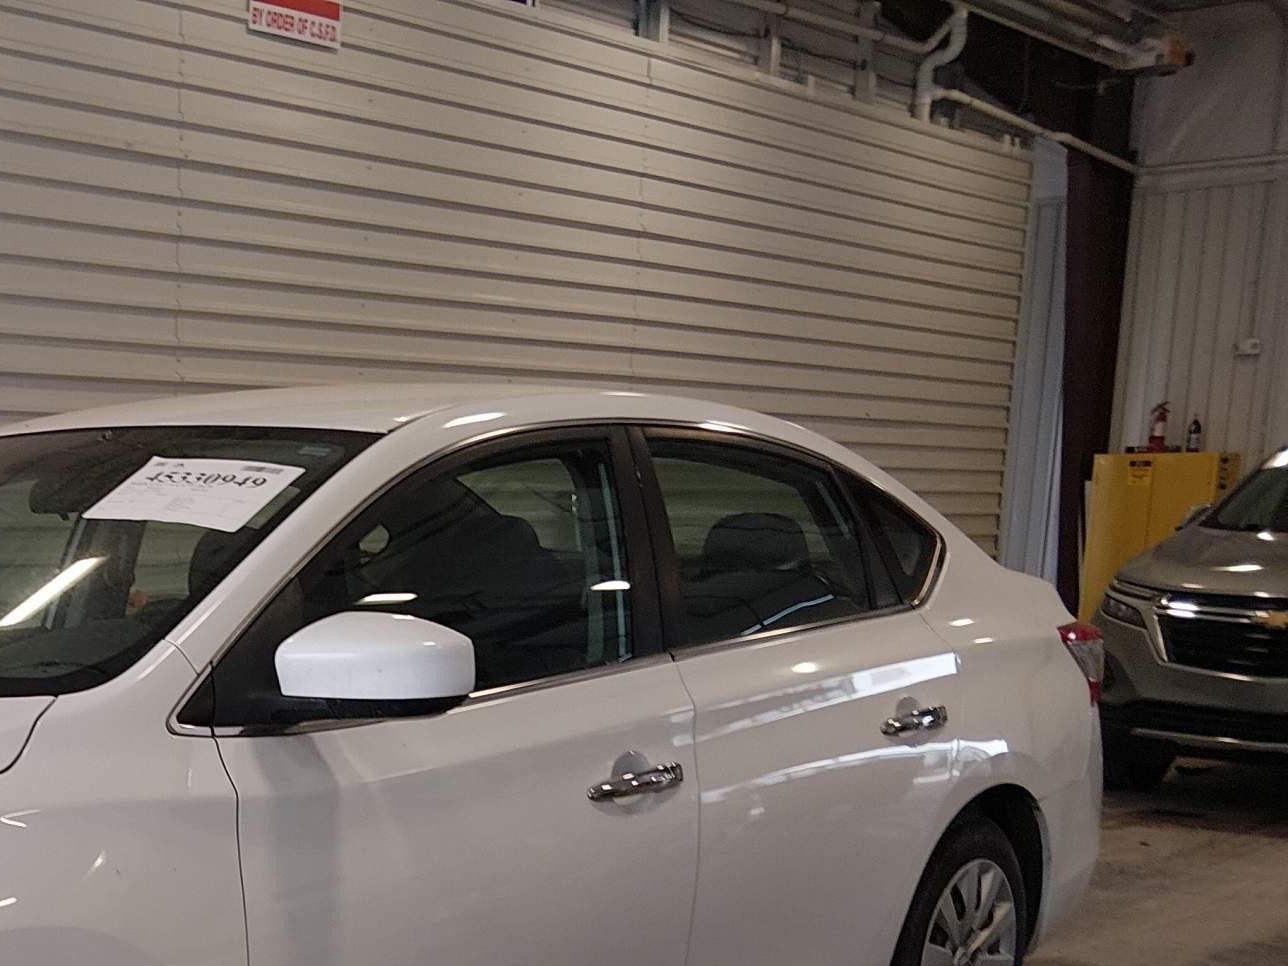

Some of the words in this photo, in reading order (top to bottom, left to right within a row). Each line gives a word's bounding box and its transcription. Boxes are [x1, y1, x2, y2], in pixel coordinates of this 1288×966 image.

[252, 7, 264, 25] BY
[265, 11, 295, 32] ORDER
[297, 17, 308, 35] OF
